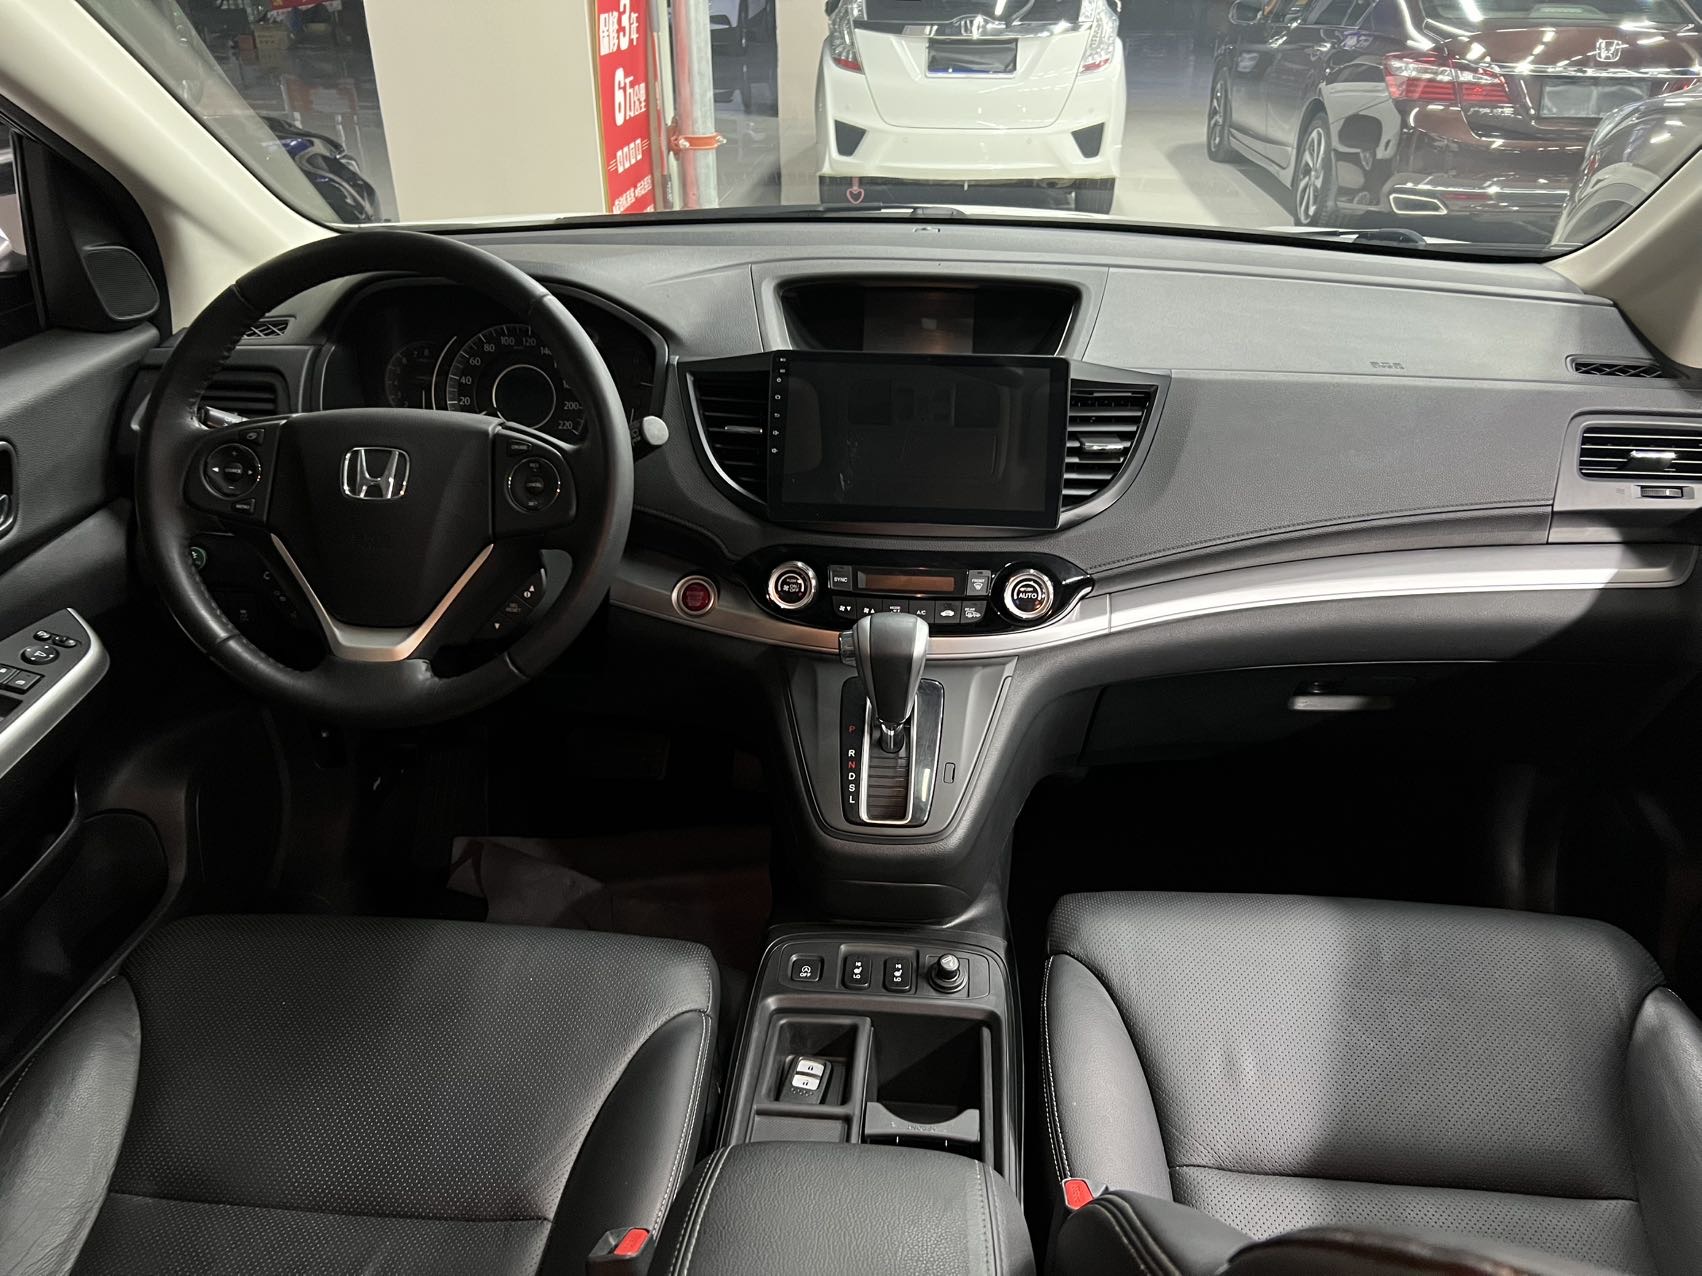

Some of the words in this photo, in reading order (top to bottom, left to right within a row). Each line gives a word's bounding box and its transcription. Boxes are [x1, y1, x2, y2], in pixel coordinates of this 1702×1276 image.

[501, 336, 515, 346] 100
[522, 337, 536, 346] 120
[484, 343, 495, 352] 80
[540, 346, 552, 356] 14
[469, 357, 481, 366] 60
[460, 375, 472, 385] 40
[459, 396, 471, 406] 20
[564, 401, 579, 410] 200
[558, 420, 573, 430] 220
[848, 725, 856, 733] P
[848, 749, 855, 757] R
[848, 761, 856, 769] N
[848, 772, 856, 780] D
[848, 783, 856, 792] S
[849, 795, 856, 804] L
